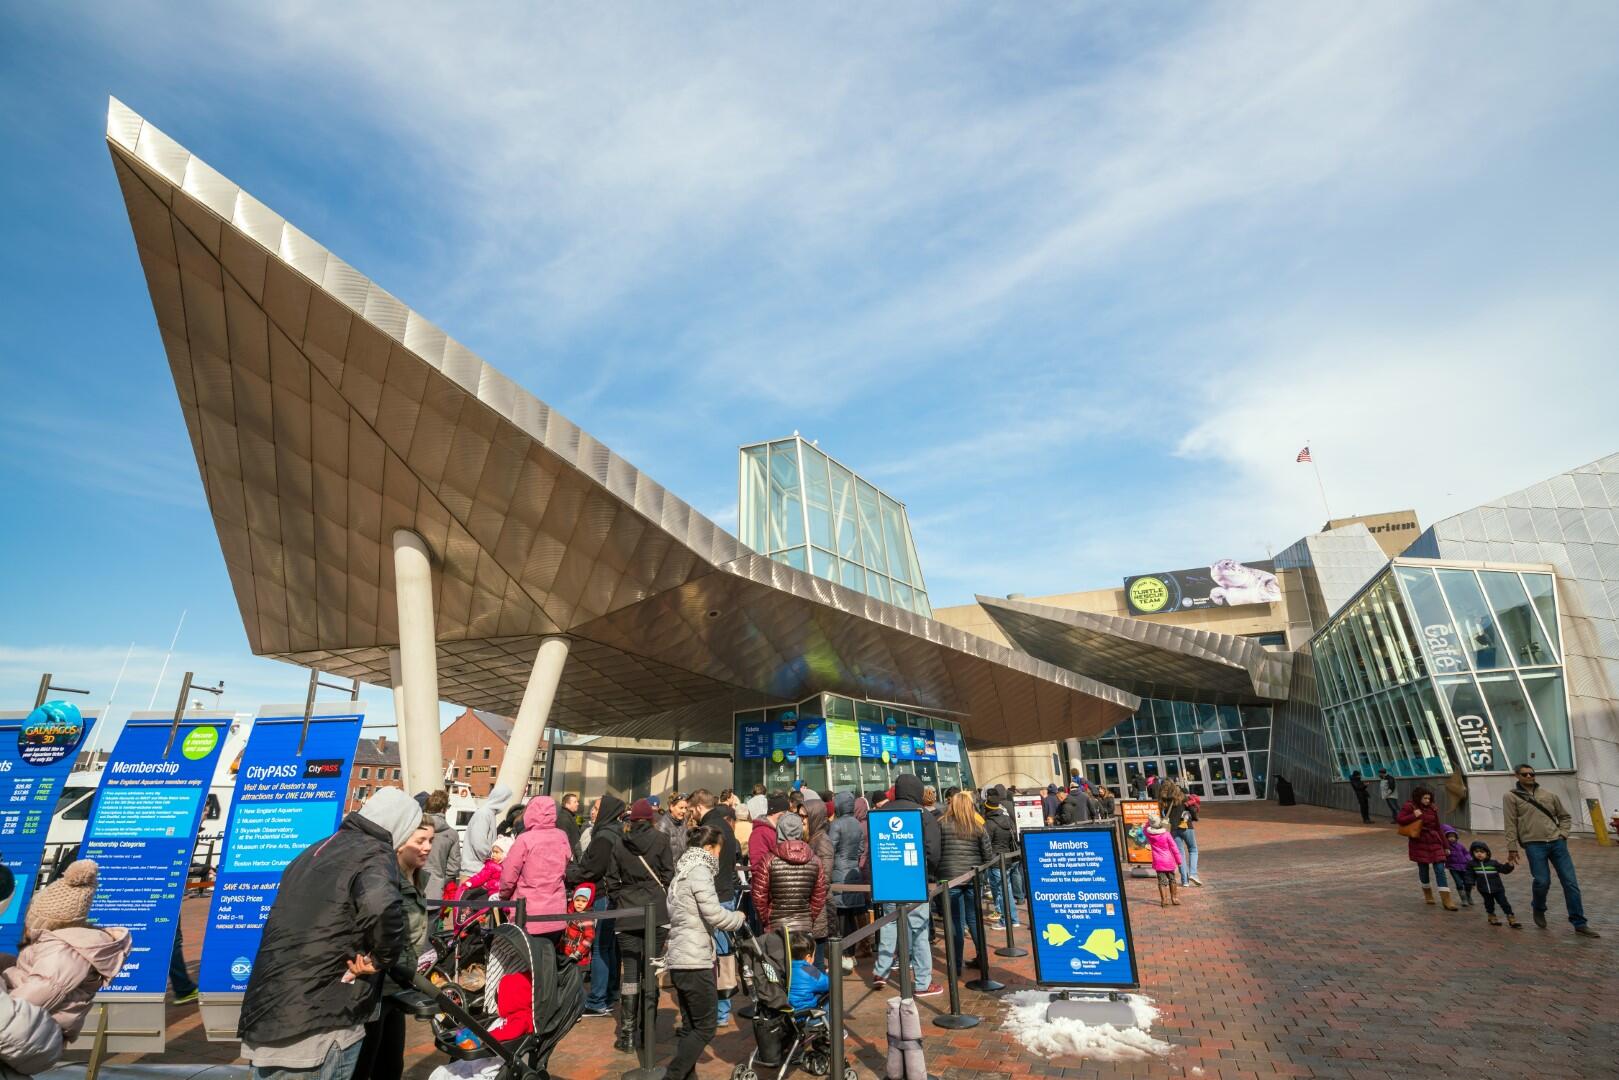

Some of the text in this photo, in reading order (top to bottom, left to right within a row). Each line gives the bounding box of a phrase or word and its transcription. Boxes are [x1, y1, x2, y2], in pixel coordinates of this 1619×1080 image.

[1424, 623, 1462, 668] Café
[25, 726, 77, 736] GALAPAGOS
[42, 735, 54, 744] 3D
[1457, 714, 1493, 766] Gifts
[111, 761, 180, 775] Membership
[246, 765, 338, 780] CityPASS CityPASS
[244, 783, 258, 791] Visit
[241, 792, 273, 800] attractions
[892, 832, 914, 840] Tickets
[1050, 840, 1088, 849] Members
[221, 896, 245, 904] CityPASS
[1035, 891, 1118, 902] Corporate Sponsors
